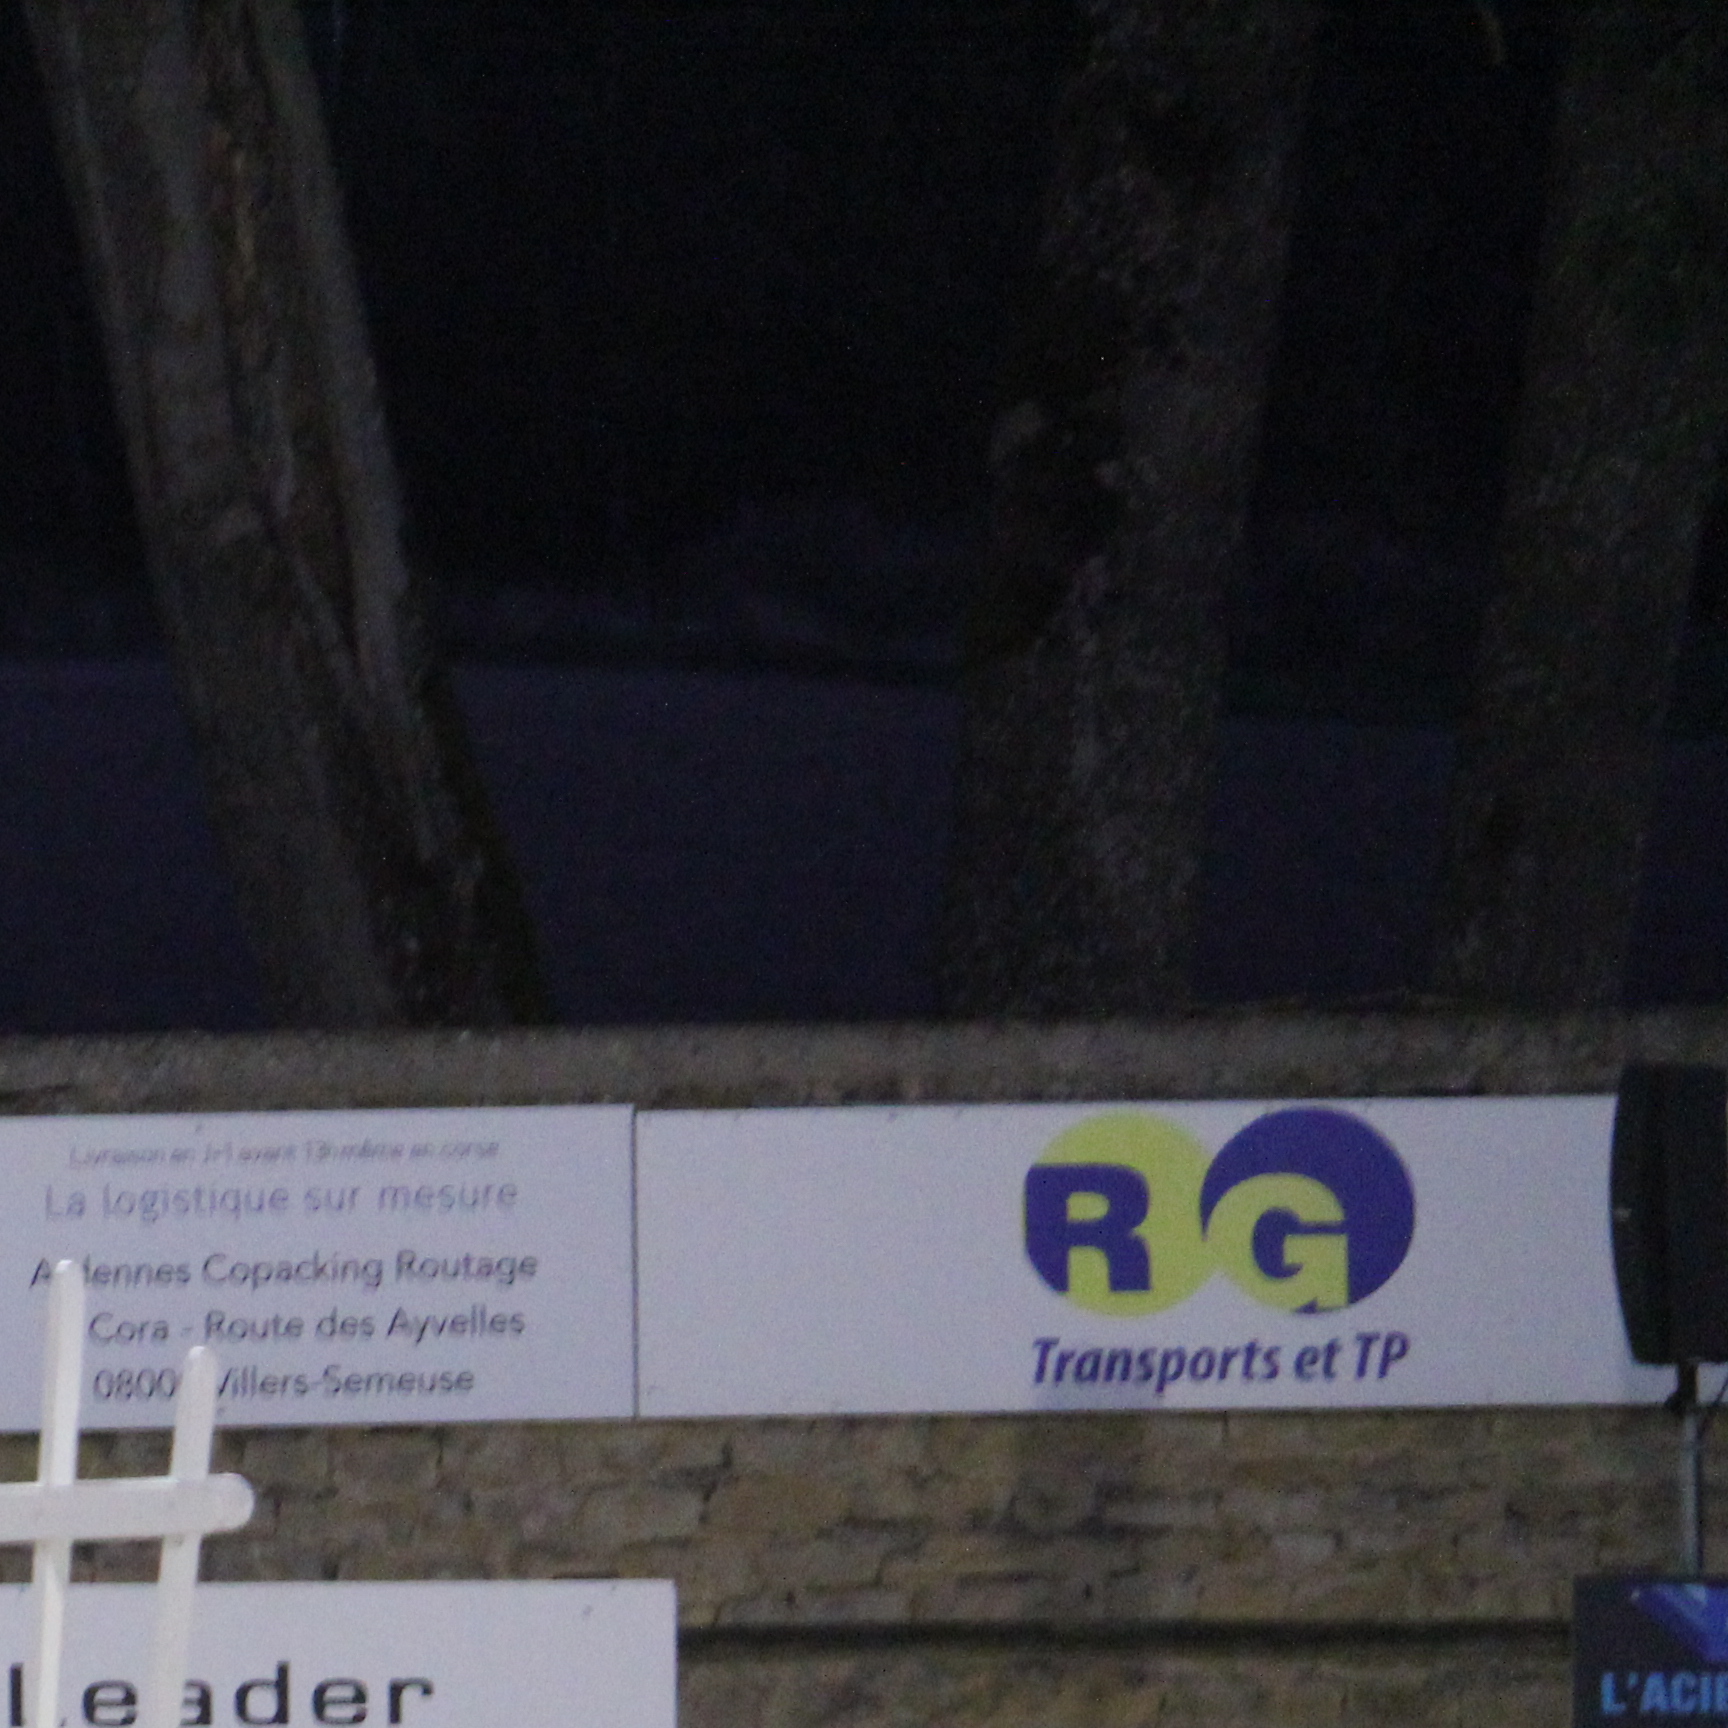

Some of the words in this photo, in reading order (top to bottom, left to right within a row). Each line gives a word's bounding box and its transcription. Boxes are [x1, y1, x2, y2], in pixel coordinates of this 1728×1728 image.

[45, 1184, 86, 1220] La
[102, 1182, 289, 1222] logistique
[304, 1184, 360, 1214] sur
[377, 1183, 518, 1212] mesure
[30, 1257, 192, 1288] Aennes
[201, 1251, 383, 1291] Copacking
[396, 1247, 539, 1287] Routage
[89, 1312, 170, 1345] Cora
[204, 1308, 304, 1343] Route
[315, 1305, 376, 1338] des
[386, 1303, 526, 1345] Ayvelles
[1031, 1337, 1282, 1392] Transports
[1294, 1340, 1343, 1380] et
[1354, 1332, 1412, 1379] TP
[94, 1368, 184, 1400] 0800
